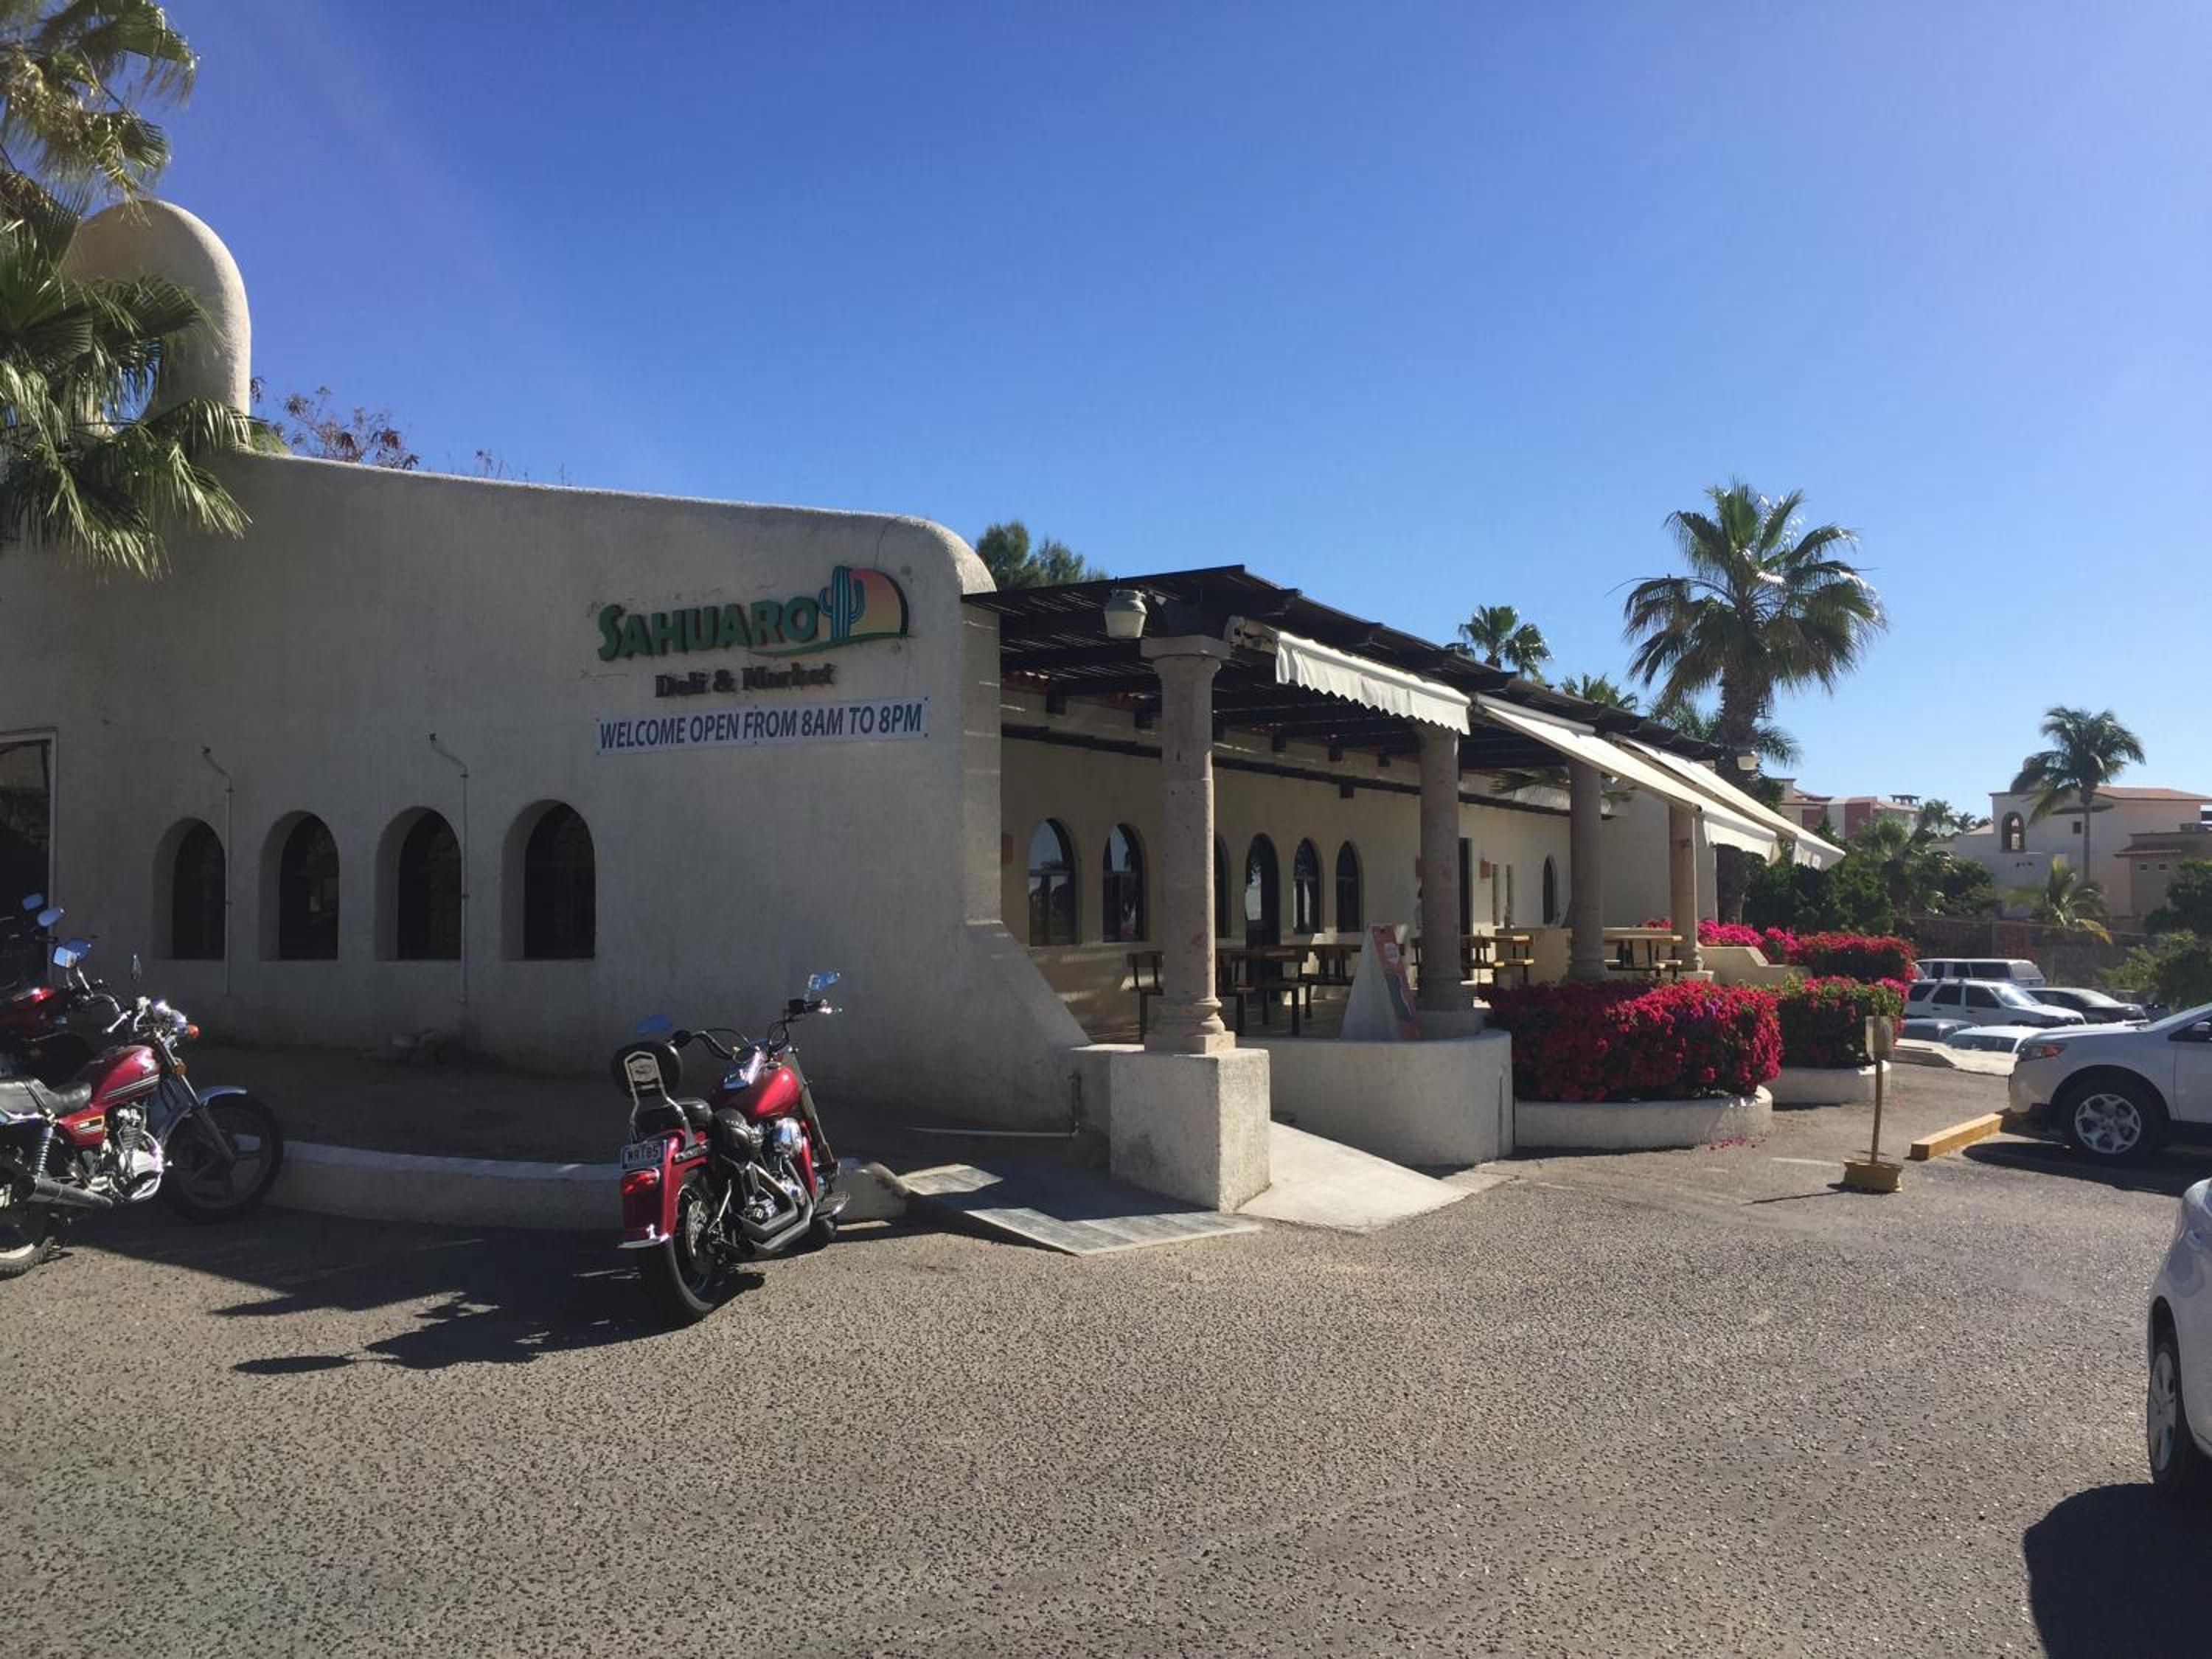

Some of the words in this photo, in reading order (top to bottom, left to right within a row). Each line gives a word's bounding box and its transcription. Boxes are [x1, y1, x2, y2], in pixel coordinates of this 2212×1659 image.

[597, 595, 819, 661] SAHUARO
[655, 672, 708, 698] Deli
[714, 669, 735, 692] &
[742, 662, 837, 690] Market
[600, 717, 686, 749] WELCOME
[689, 713, 739, 743] OPEN
[743, 709, 799, 740] FROM
[801, 707, 844, 737] 8AM
[849, 705, 877, 734] TO
[879, 703, 922, 733] 8PM
